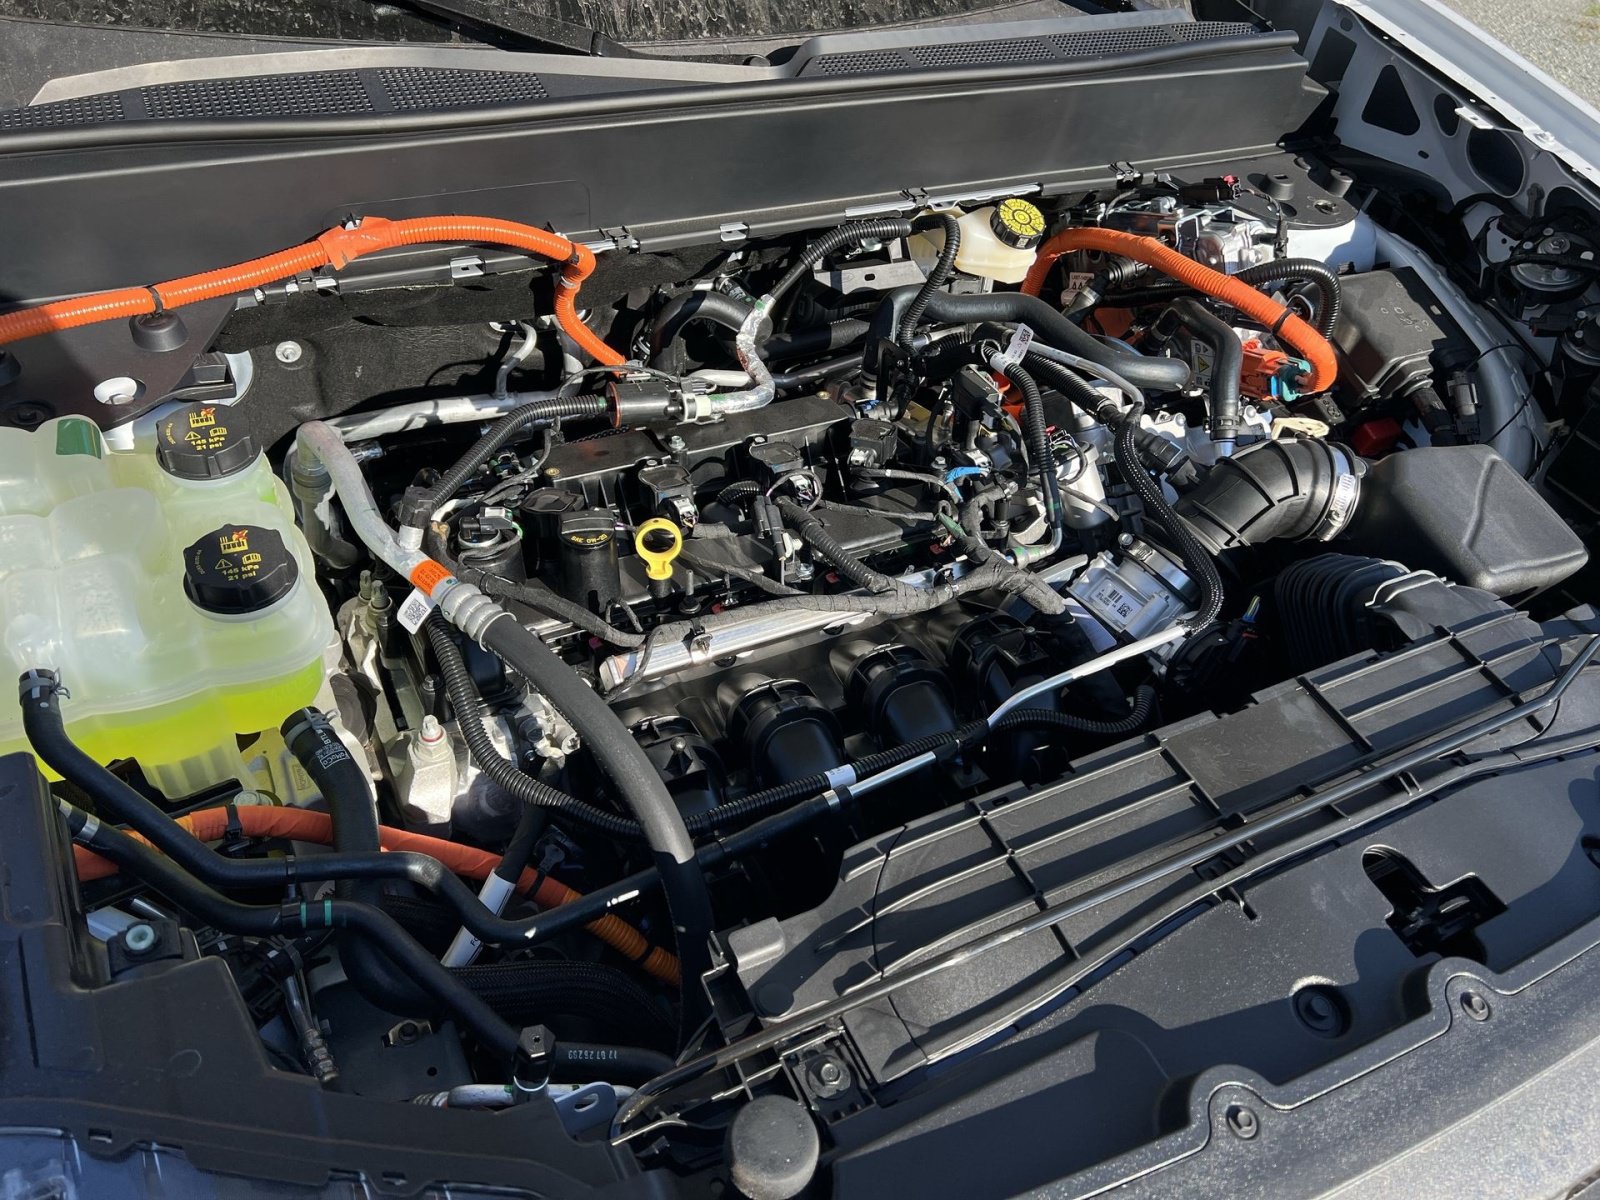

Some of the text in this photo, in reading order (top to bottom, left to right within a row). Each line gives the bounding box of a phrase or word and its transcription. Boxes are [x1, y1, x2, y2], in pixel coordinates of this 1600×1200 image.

[222, 564, 260, 575] 145 kPa
[242, 571, 257, 580] psi
